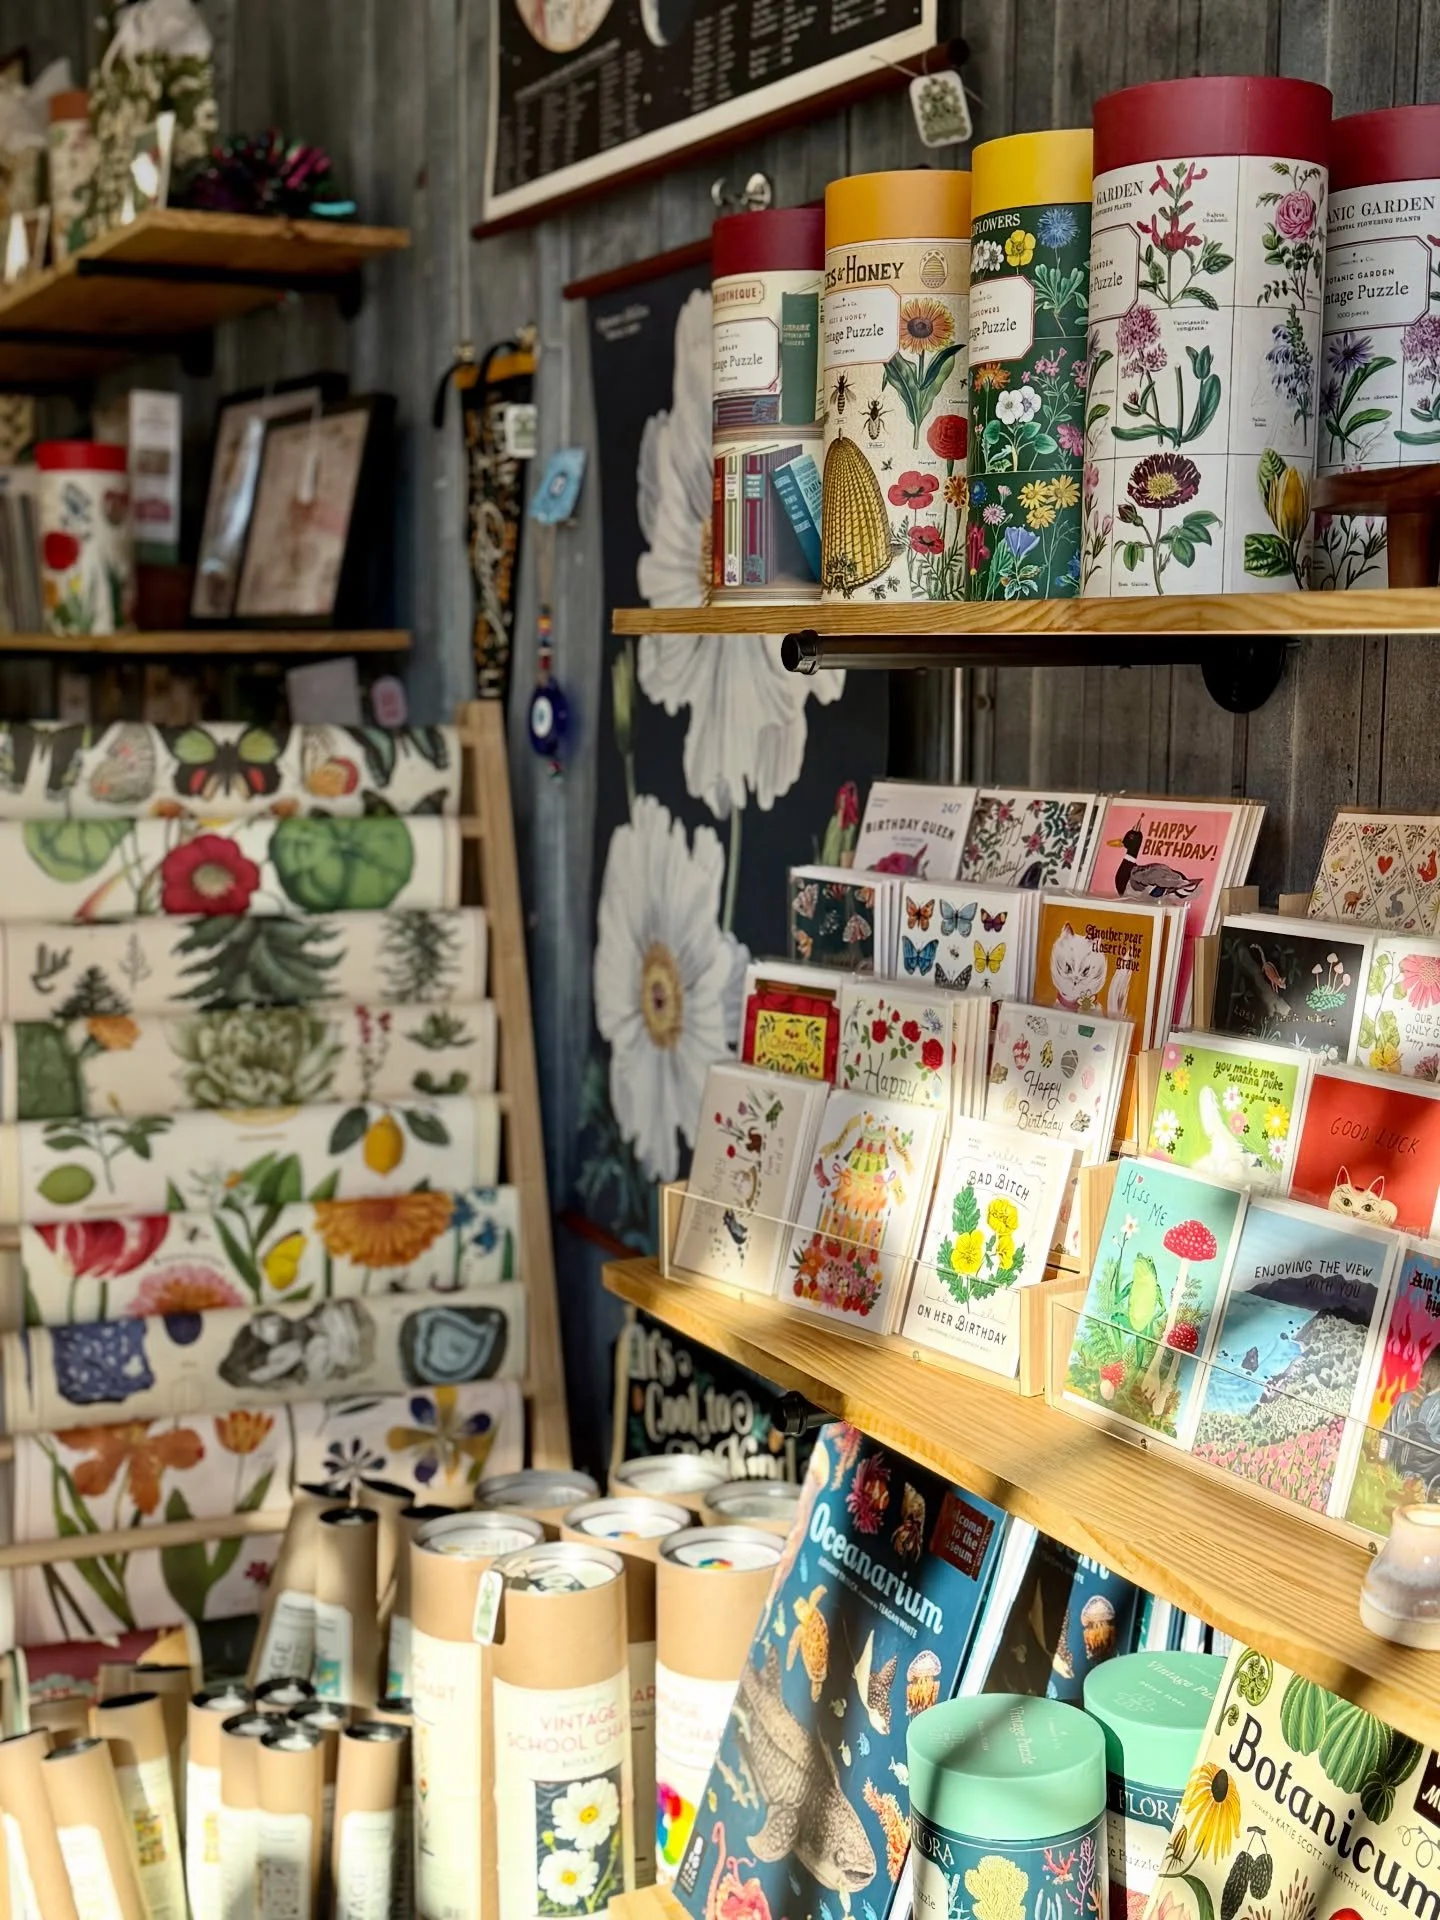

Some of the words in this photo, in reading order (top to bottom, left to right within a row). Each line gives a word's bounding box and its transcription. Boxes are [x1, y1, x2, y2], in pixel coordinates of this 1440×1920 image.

[1096, 181, 1144, 205] GARDEN
[1361, 196, 1436, 217] GARDEN
[1357, 218, 1393, 229] FLOWERING
[1395, 215, 1421, 223] PLANTS
[846, 255, 904, 284] HONEY
[1357, 269, 1395, 279] GARDEN
[1094, 272, 1123, 292] Puzzle
[1357, 281, 1409, 300] Puzzle
[846, 323, 884, 339] Puzzle
[982, 318, 1017, 335] Puzzle
[729, 353, 763, 368] Puzzle
[941, 802, 962, 815] 24/7
[866, 817, 919, 834] BIRTHDAY
[921, 820, 956, 841] QUEEN
[1147, 821, 1197, 841] HAPPY
[1142, 841, 1218, 862] BIRTHDAY!
[1085, 923, 1123, 942] Another
[1123, 932, 1144, 945] year
[1092, 941, 1118, 954] closer
[1118, 944, 1127, 956] to
[1129, 944, 1142, 958] the
[1115, 957, 1140, 972] grave
[1414, 1013, 1433, 1025] OUR
[1405, 1024, 1431, 1036] ONLY
[863, 1052, 918, 1099] Happy
[1213, 1061, 1232, 1078] you
[1233, 1061, 1259, 1077] make
[1023, 1070, 1063, 1110] Happy
[1227, 1073, 1259, 1087] wanna
[1260, 1076, 1284, 1094] puke
[1249, 1092, 1267, 1105] good
[1017, 1100, 1064, 1138] Birthday
[1330, 1116, 1369, 1142] GOOD
[1375, 1126, 1421, 1155] LUCK
[967, 1170, 992, 1186] BAD
[995, 1173, 1030, 1201] BITCH
[1255, 1259, 1312, 1279] ENJOYING
[1319, 1260, 1340, 1274] THE
[1345, 1261, 1374, 1279] VIEW
[1305, 1279, 1336, 1293] WITH
[1339, 1281, 1361, 1299] YOU
[917, 1303, 932, 1319] ON
[934, 1310, 953, 1327] HER
[955, 1314, 1007, 1346] BIRTHDAY
[952, 1510, 983, 1537] lcome
[962, 1531, 978, 1551] the
[808, 1501, 944, 1636] Oceanarium
[540, 1701, 617, 1730] VINTAGE
[507, 1730, 589, 1754] SCHOOL
[1229, 1713, 1440, 1920] Botanicum
[1275, 1817, 1297, 1840] KATIE
[1296, 1834, 1323, 1861] SCOTT
[1331, 1863, 1361, 1893] KATHY
[1360, 1887, 1390, 1917] WILLIS
